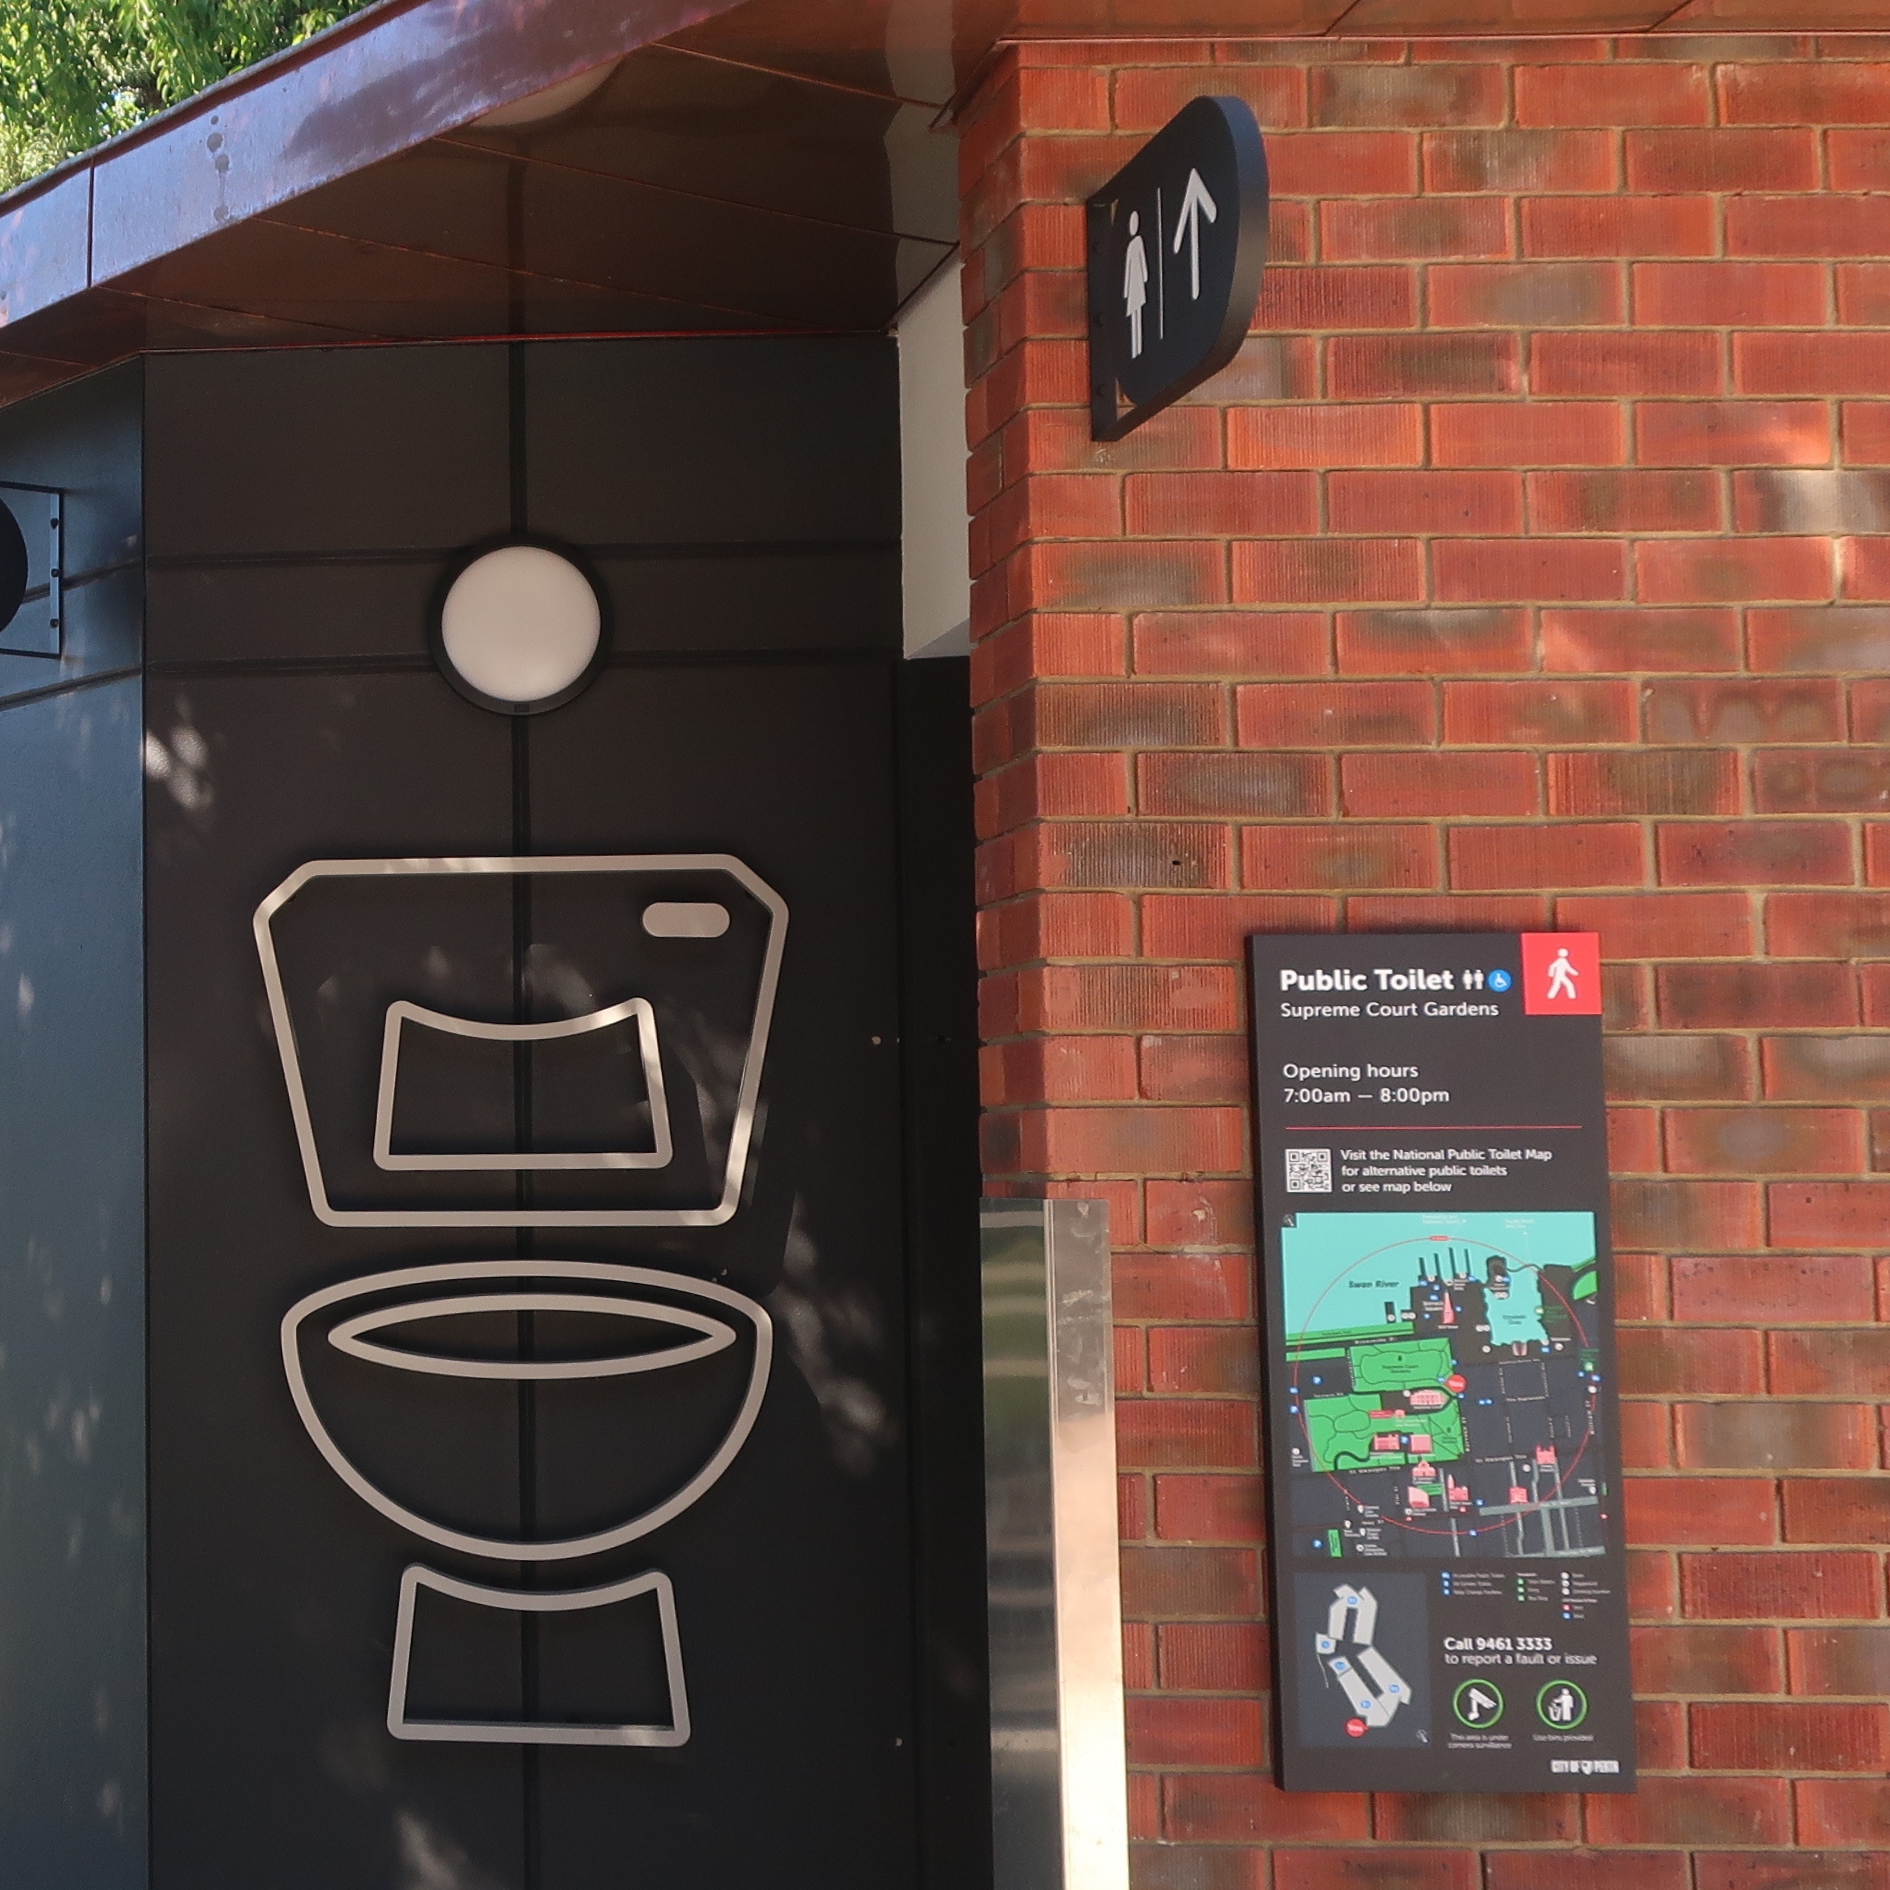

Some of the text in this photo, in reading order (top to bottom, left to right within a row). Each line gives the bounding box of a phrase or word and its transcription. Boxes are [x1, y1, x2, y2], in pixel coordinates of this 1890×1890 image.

[1280, 968, 1455, 991] Public Toilet
[1280, 1001, 1499, 1021] Supreme Court Gardens
[1283, 1063, 1419, 1082] Opening hours
[1284, 1087, 1351, 1103] 7:00am
[1380, 1087, 1450, 1106] 8:00pm
[1340, 1148, 1553, 1162] Visit the National Public Toilet Map
[1341, 1164, 1508, 1179] for alternative public toilets
[1341, 1180, 1452, 1195] or see map below
[1348, 1280, 1400, 1289] Swan River
[1443, 1637, 1553, 1651] Call 9461 3333
[1444, 1652, 1598, 1667] to report a fault or issue
